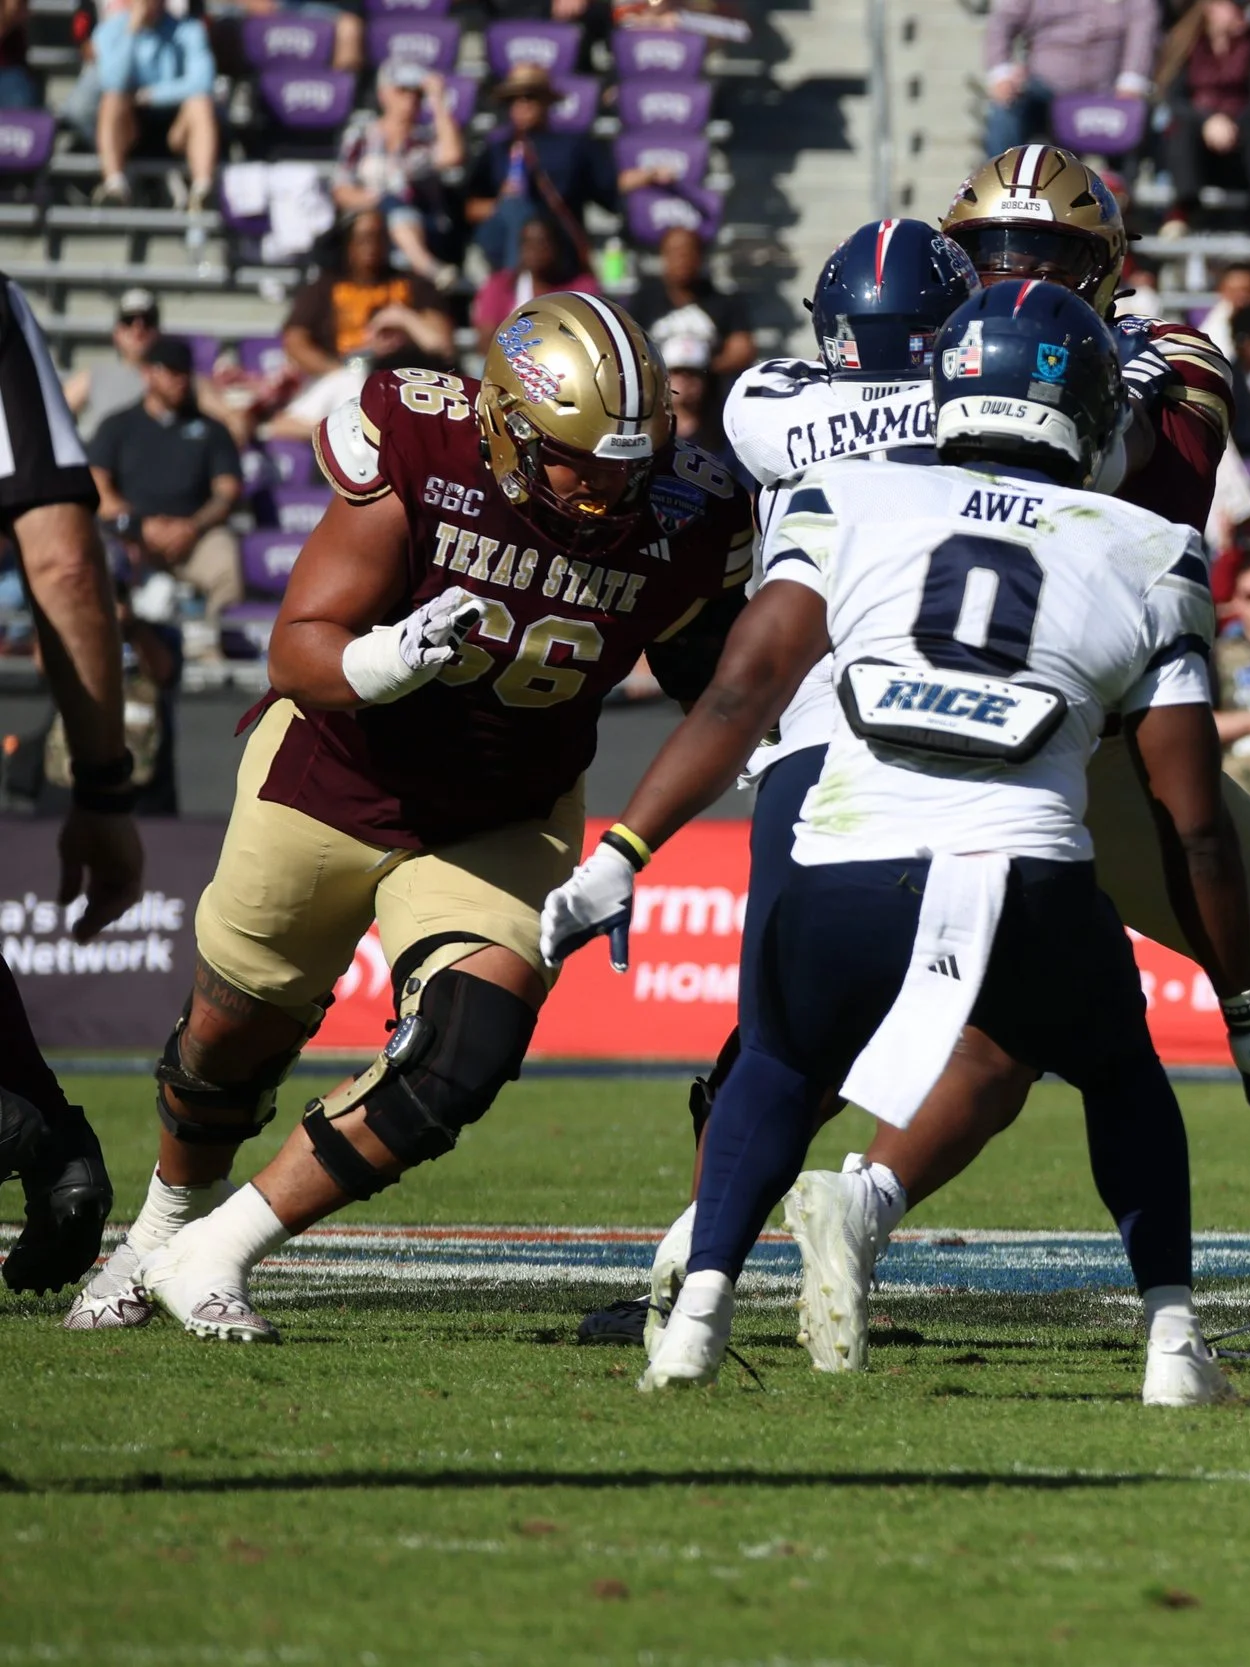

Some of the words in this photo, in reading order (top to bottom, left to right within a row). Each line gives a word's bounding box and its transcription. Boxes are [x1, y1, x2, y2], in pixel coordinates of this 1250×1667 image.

[1001, 201, 1041, 212] BOBCATS
[980, 401, 1027, 418] OWLS
[611, 437, 646, 447] BOBCATS
[424, 477, 485, 517] SBC
[960, 489, 1043, 529] AWE
[432, 521, 539, 590] TEXAS
[542, 554, 648, 613] STATE
[909, 529, 1048, 681] 0
[876, 680, 1021, 728] RICE
[1, 932, 174, 975] Network
